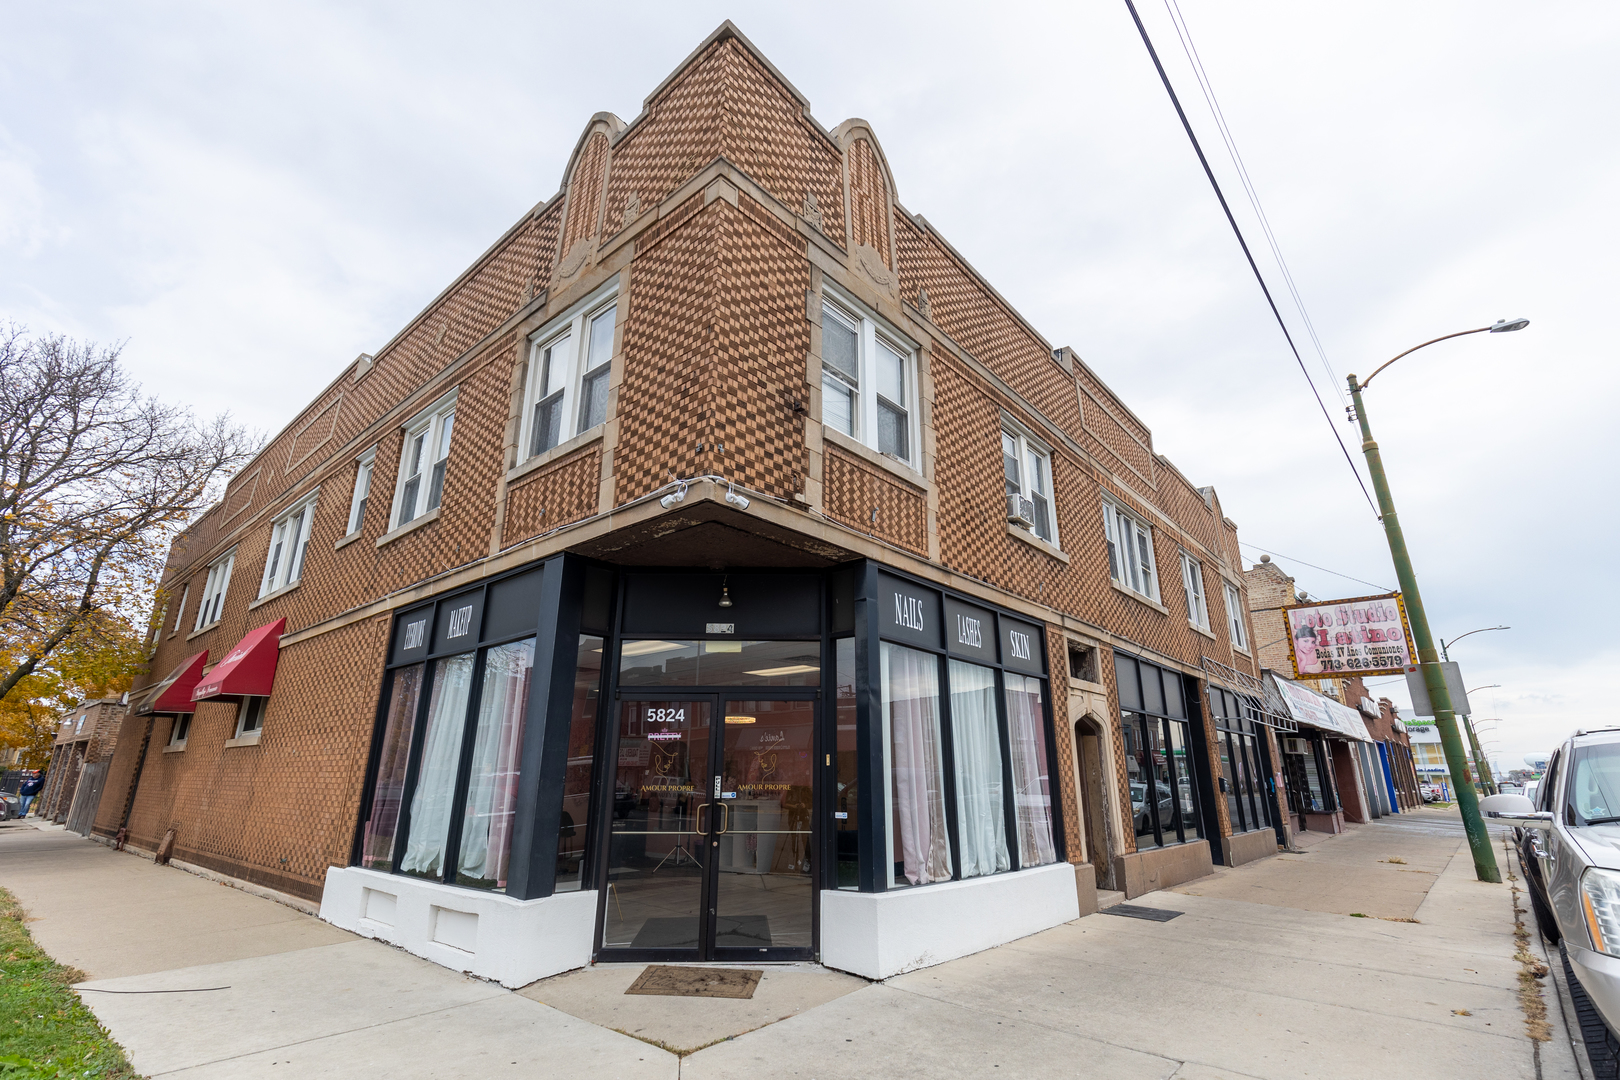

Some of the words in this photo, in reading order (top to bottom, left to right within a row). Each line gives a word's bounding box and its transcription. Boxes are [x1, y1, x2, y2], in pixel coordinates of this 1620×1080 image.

[447, 605, 473, 639] MAKEUP
[894, 592, 924, 632] NAILS
[1292, 608, 1333, 630] Foto
[1334, 601, 1397, 626] Studio
[957, 614, 982, 648] LASHES
[1317, 625, 1402, 647] Latino
[1010, 630, 1031, 661] SKIN
[1315, 648, 1334, 659] Bodas
[1335, 646, 1344, 657] XV
[1364, 644, 1404, 655] Comuniones
[647, 708, 685, 722] 5824
[647, 731, 681, 740] PRETTY
[640, 784, 666, 792] AMOUR
[737, 783, 763, 791] AMOUR
[764, 783, 791, 791] PROPRE
